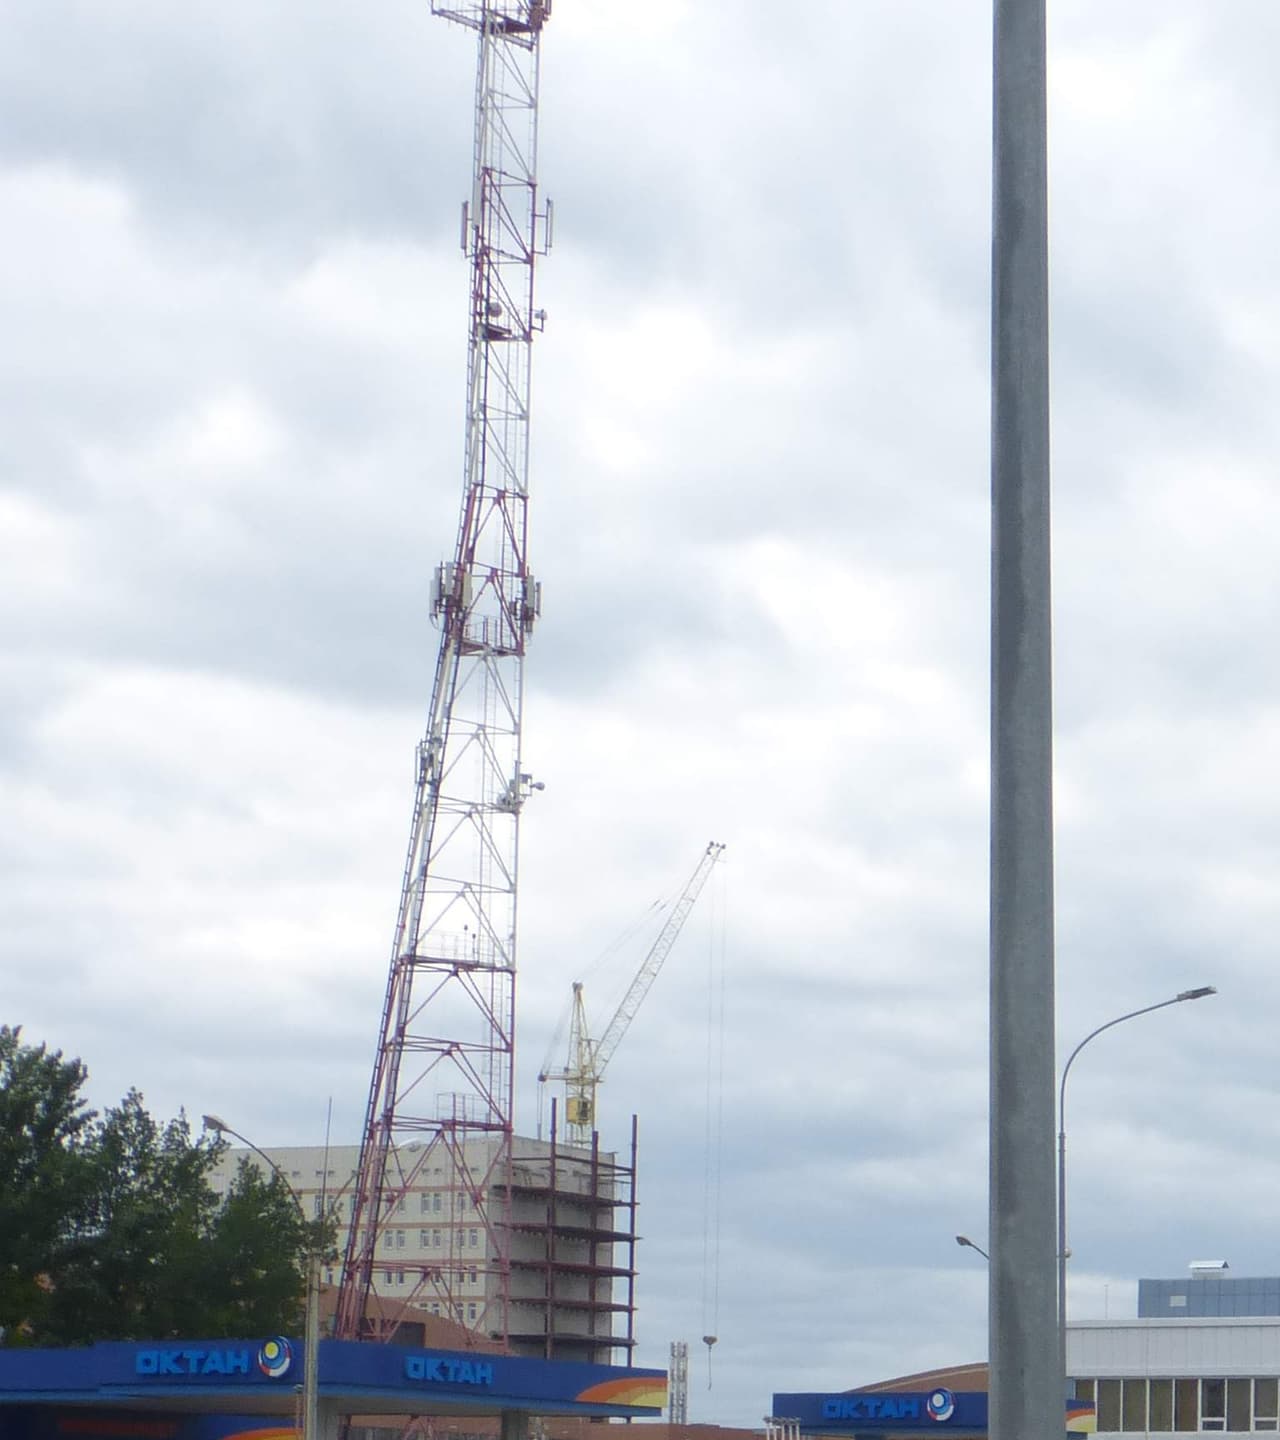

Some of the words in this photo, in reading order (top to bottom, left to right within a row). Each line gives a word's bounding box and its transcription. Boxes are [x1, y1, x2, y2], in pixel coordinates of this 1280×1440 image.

[135, 1350, 249, 1374] ОКТАН
[405, 1356, 493, 1384] ОКТАН
[823, 1398, 919, 1418] ОКТАН
